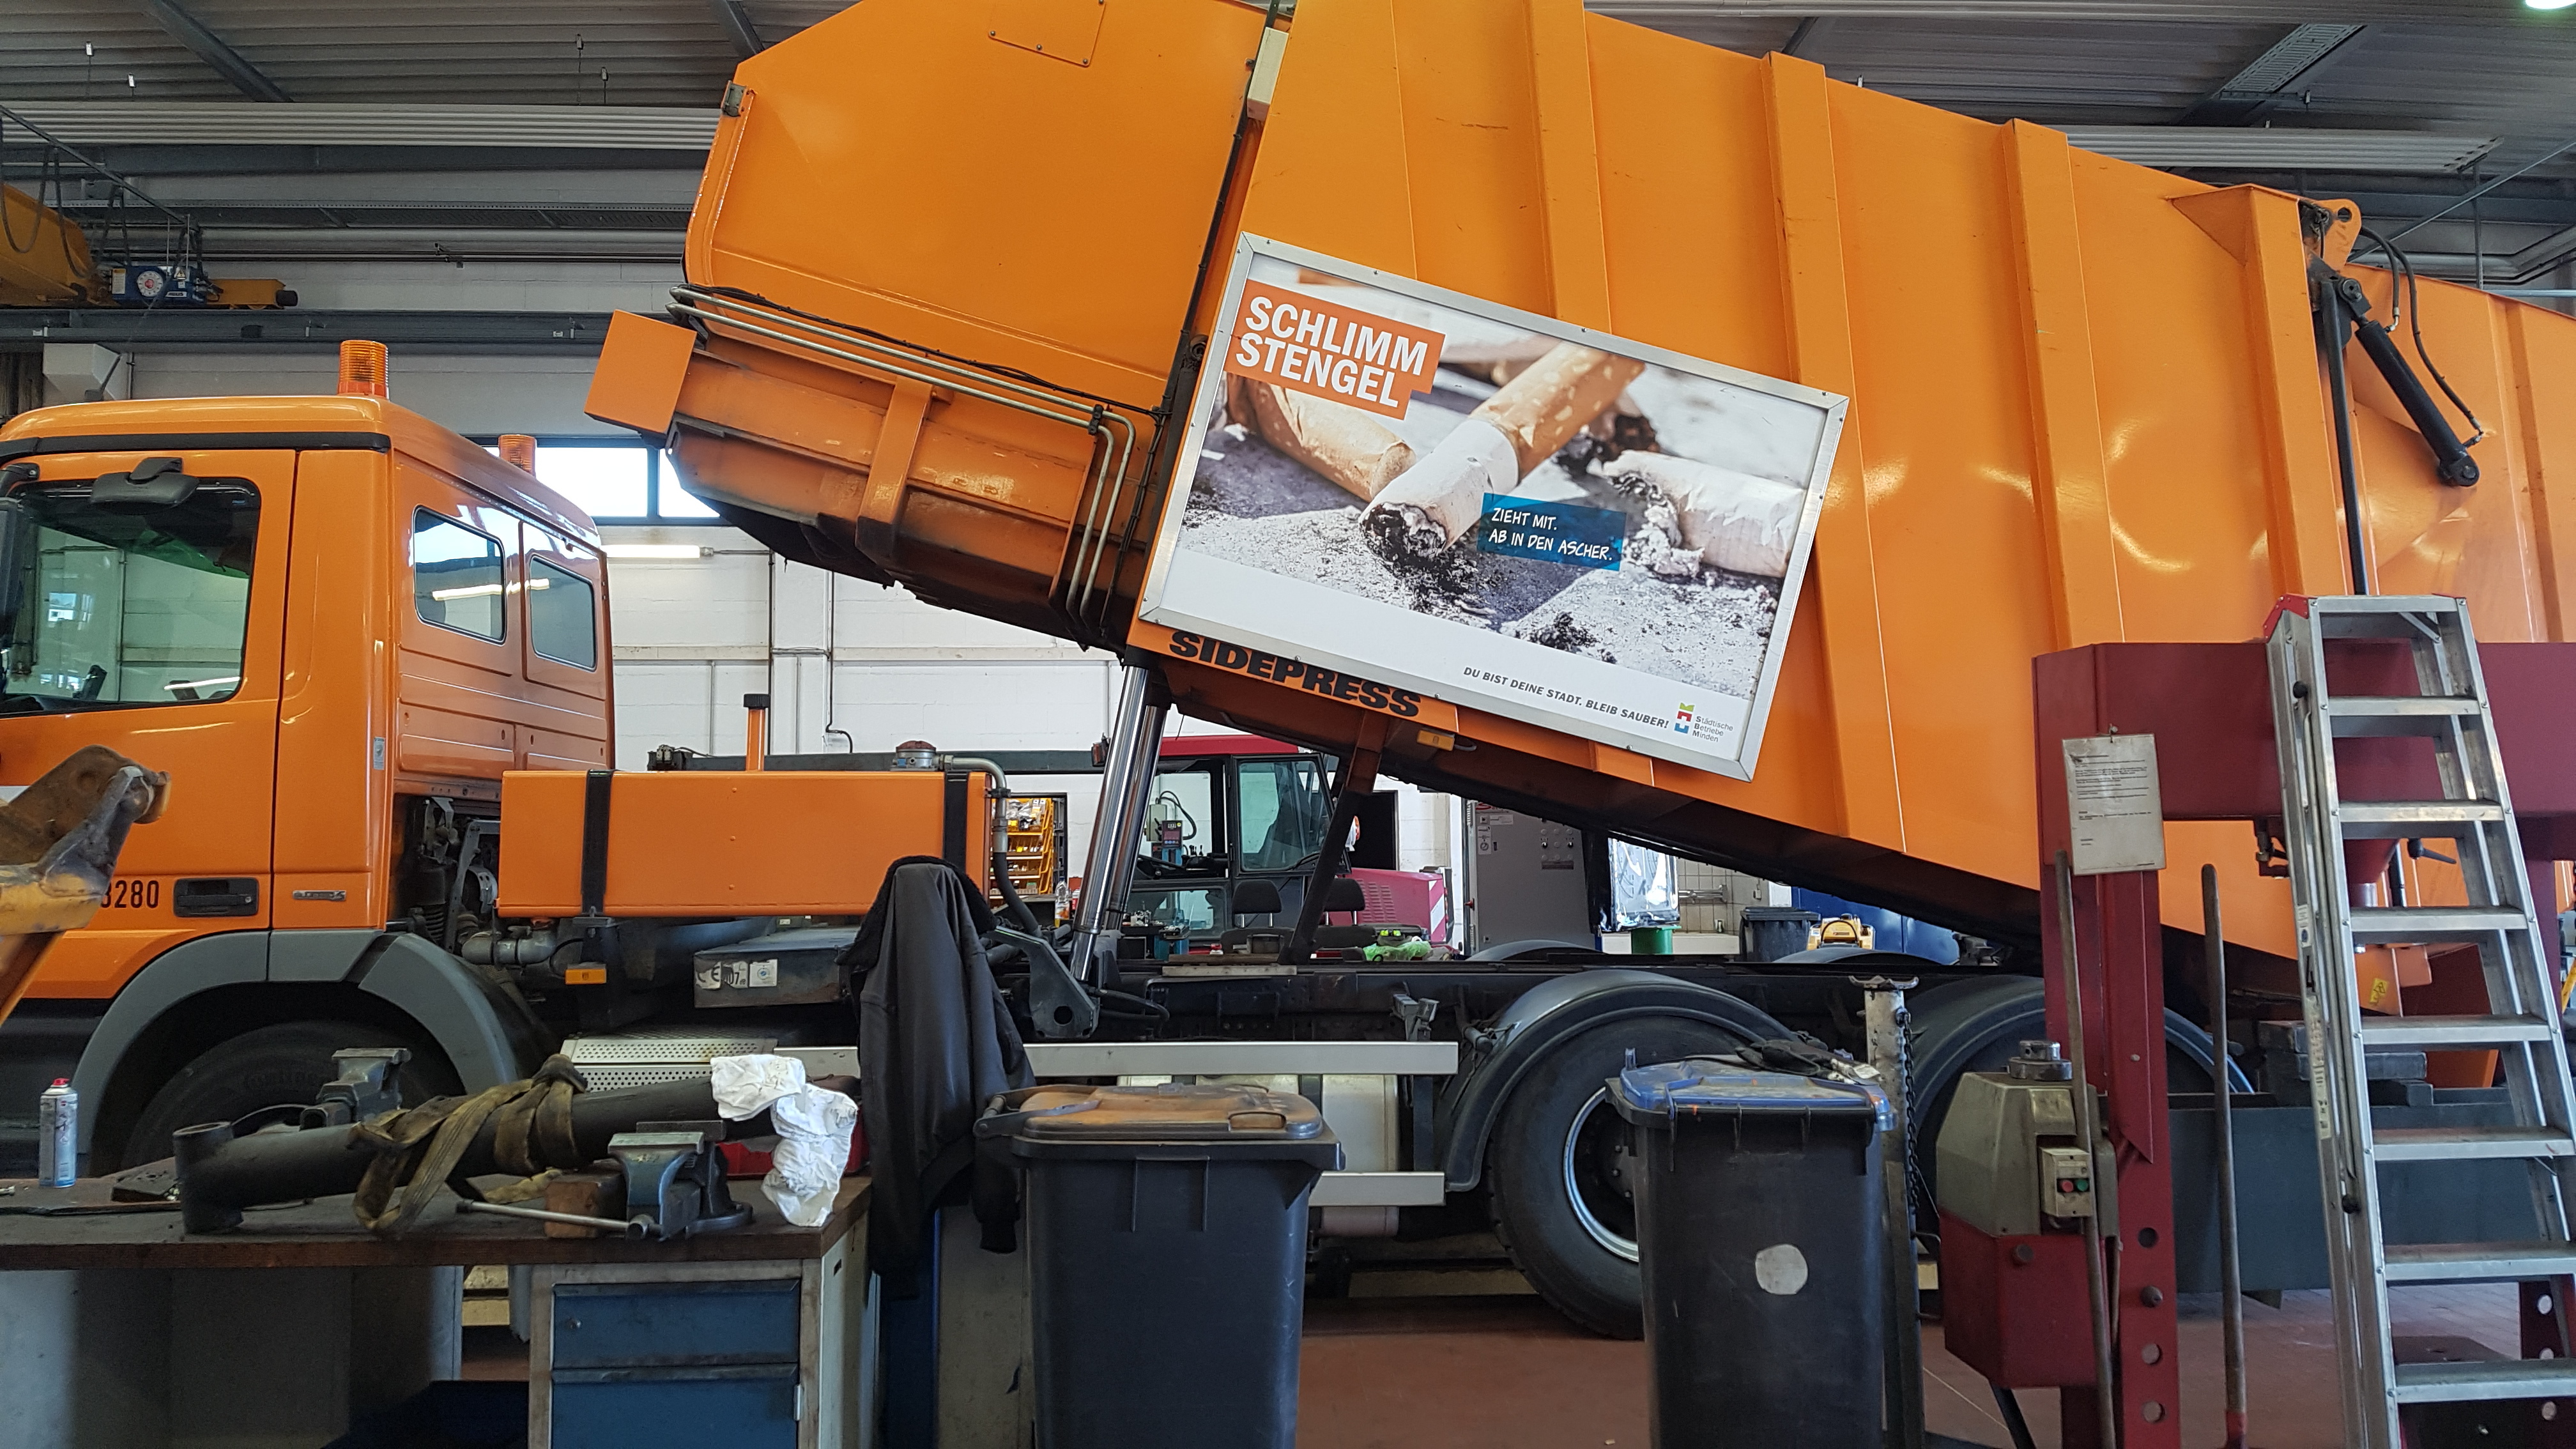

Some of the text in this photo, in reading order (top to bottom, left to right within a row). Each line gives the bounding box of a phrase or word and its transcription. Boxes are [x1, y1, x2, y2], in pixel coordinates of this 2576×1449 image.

[1246, 296, 1428, 376] SCHLIMM
[1236, 333, 1399, 408] STENGEL
[1492, 507, 1557, 530] ZIEHT MIT.
[1489, 529, 1613, 561] AB IN DEN ASCHER.
[1169, 631, 1422, 717] SIDEPRESS
[1464, 666, 1669, 729] DU BIST DEINE STADT. BLEIB SAUBER!
[1692, 730, 1719, 742] Minden
[1694, 723, 1724, 736] Betriebe
[1696, 716, 1733, 732] Städtische
